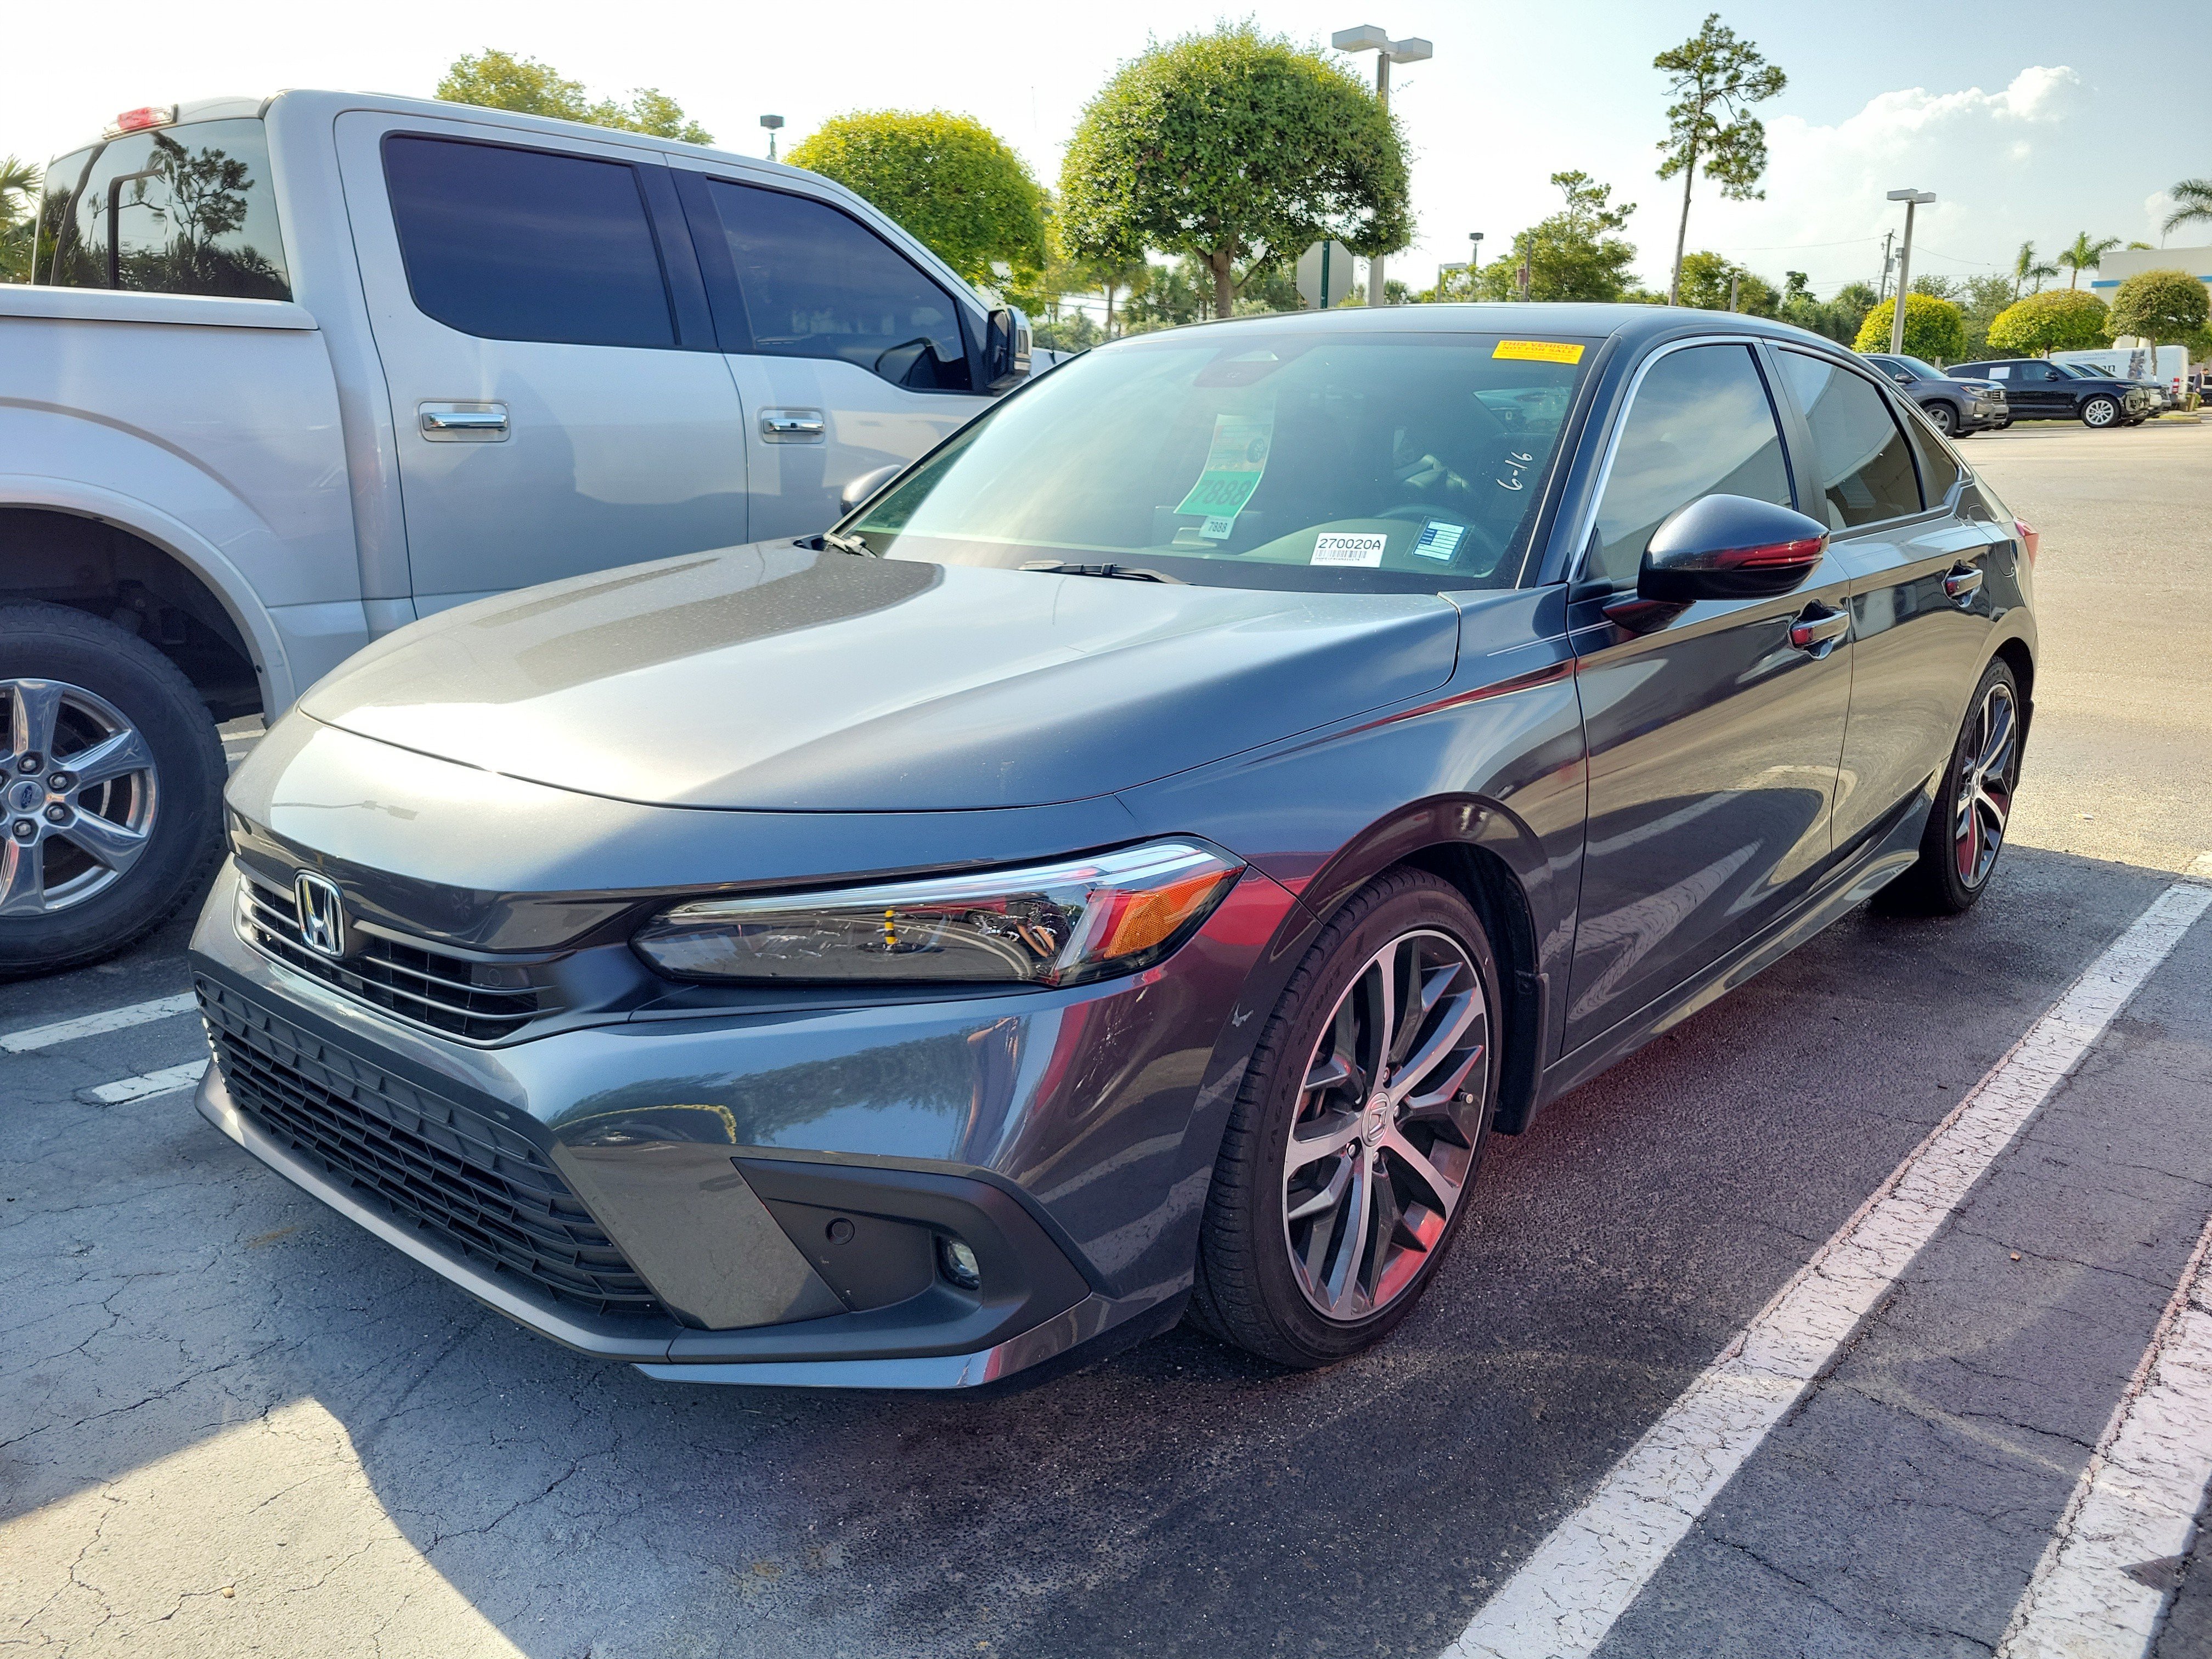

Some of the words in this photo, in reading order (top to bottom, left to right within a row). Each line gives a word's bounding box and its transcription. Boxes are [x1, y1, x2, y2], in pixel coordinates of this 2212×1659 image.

[1496, 451, 1533, 490] 6-16
[1190, 479, 1252, 506] 7888
[1208, 521, 1228, 533] 7888
[1318, 538, 1381, 550] 270020A
[1297, 961, 1343, 1046] SPORT
